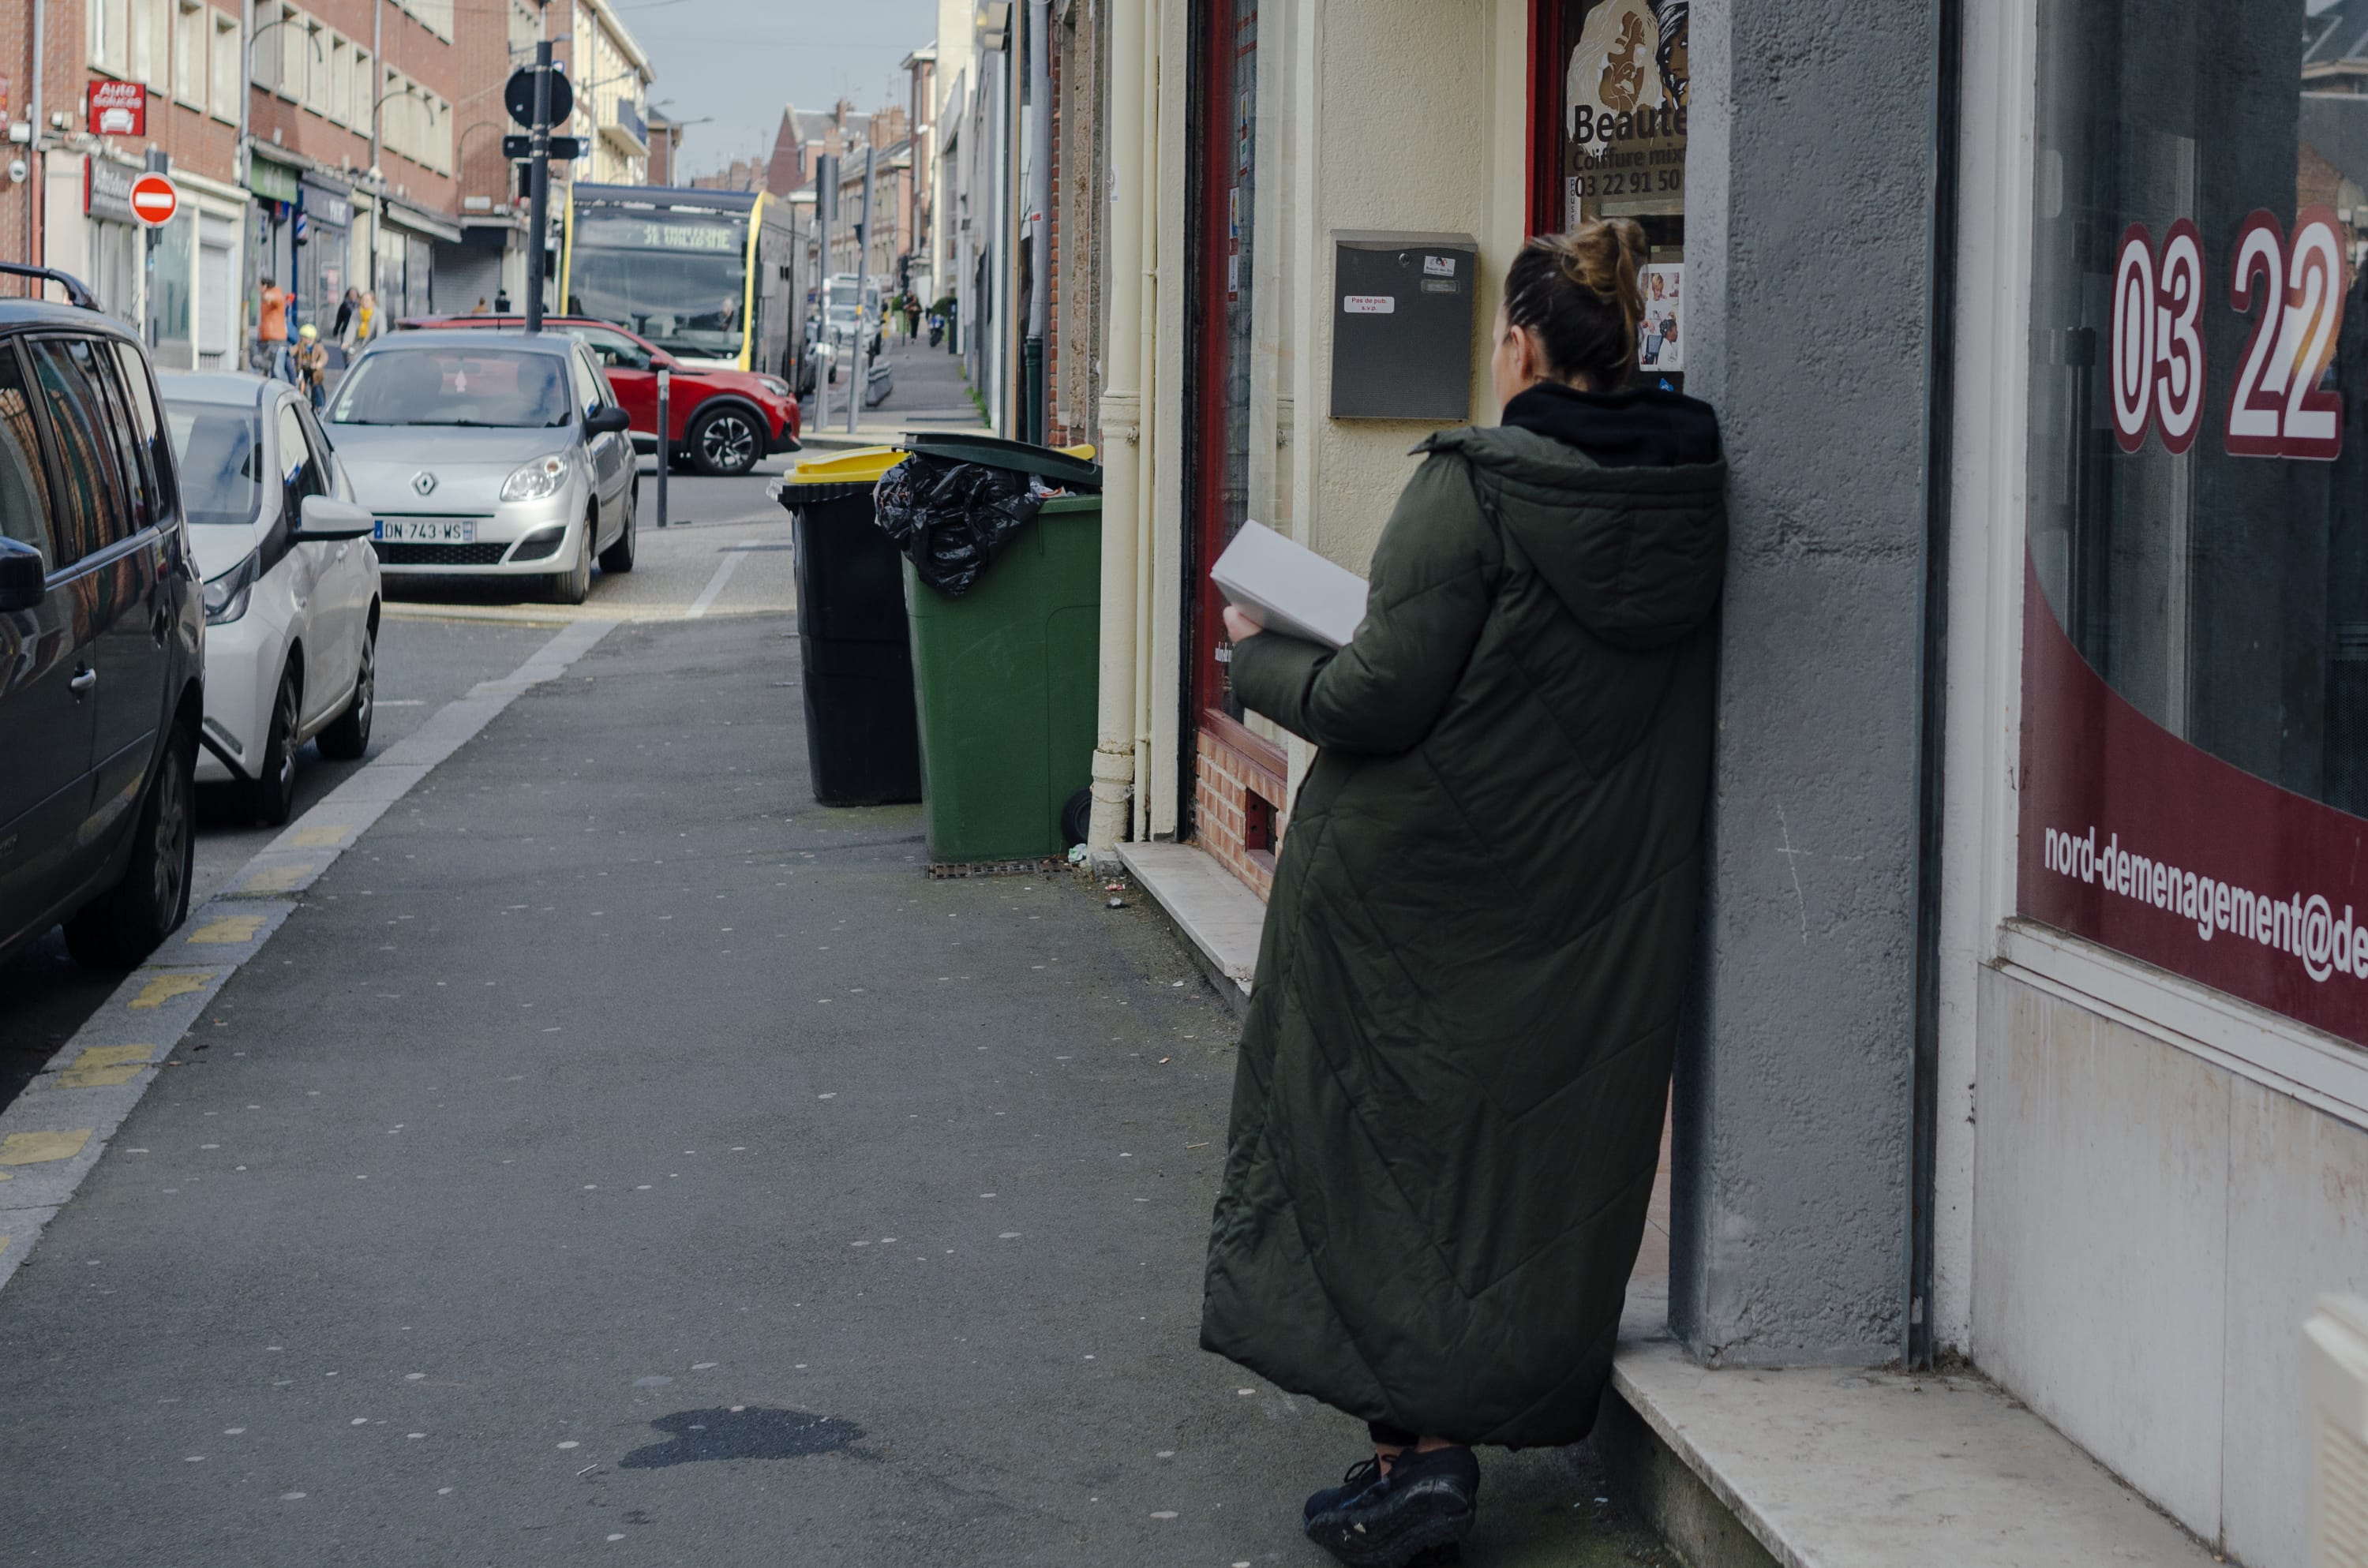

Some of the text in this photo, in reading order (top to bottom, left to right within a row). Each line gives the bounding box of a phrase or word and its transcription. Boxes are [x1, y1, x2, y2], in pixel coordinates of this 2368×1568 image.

[99, 82, 137, 96] Auto
[1572, 146, 1644, 171] Coiffure
[1576, 169, 1680, 196] 03 22 91 50
[2112, 216, 2339, 443] 03 22
[2044, 826, 2368, 983] nord-demenagement@de
